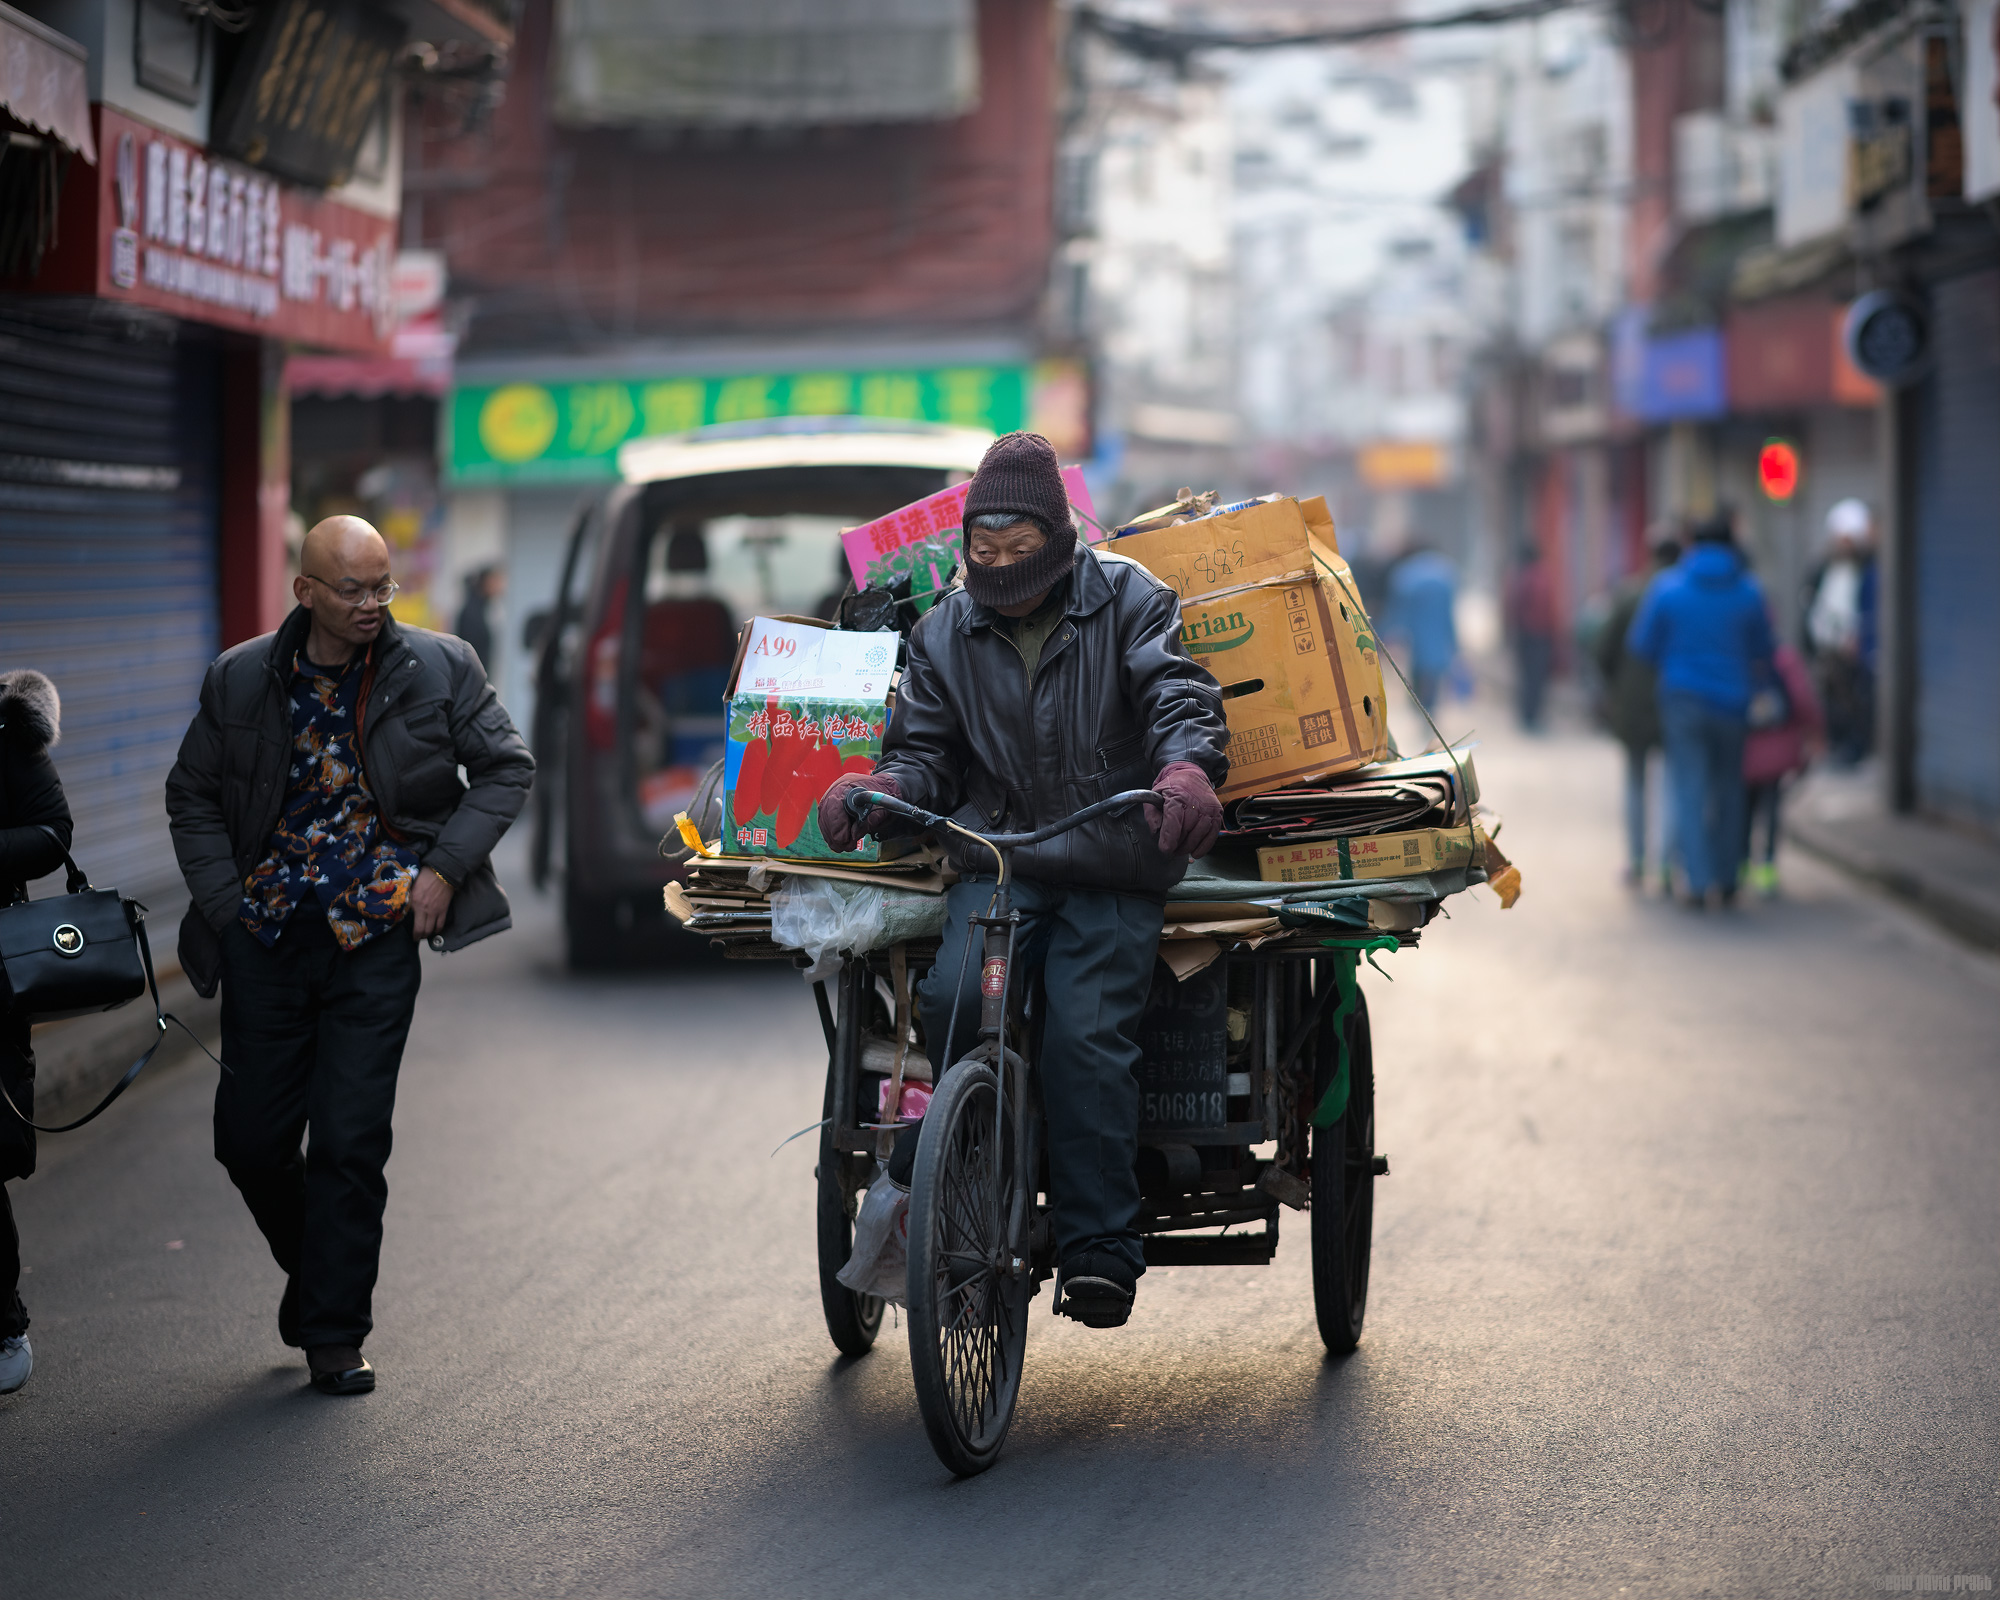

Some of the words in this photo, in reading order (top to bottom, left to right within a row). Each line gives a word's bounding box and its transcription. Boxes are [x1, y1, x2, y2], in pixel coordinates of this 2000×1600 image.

[869, 487, 968, 554] 精选蔬
[862, 682, 873, 693] S
[746, 710, 871, 741] 精品红泡椒
[1303, 714, 1330, 731] 基地
[1306, 728, 1333, 746] 直供
[737, 827, 768, 846] 中国
